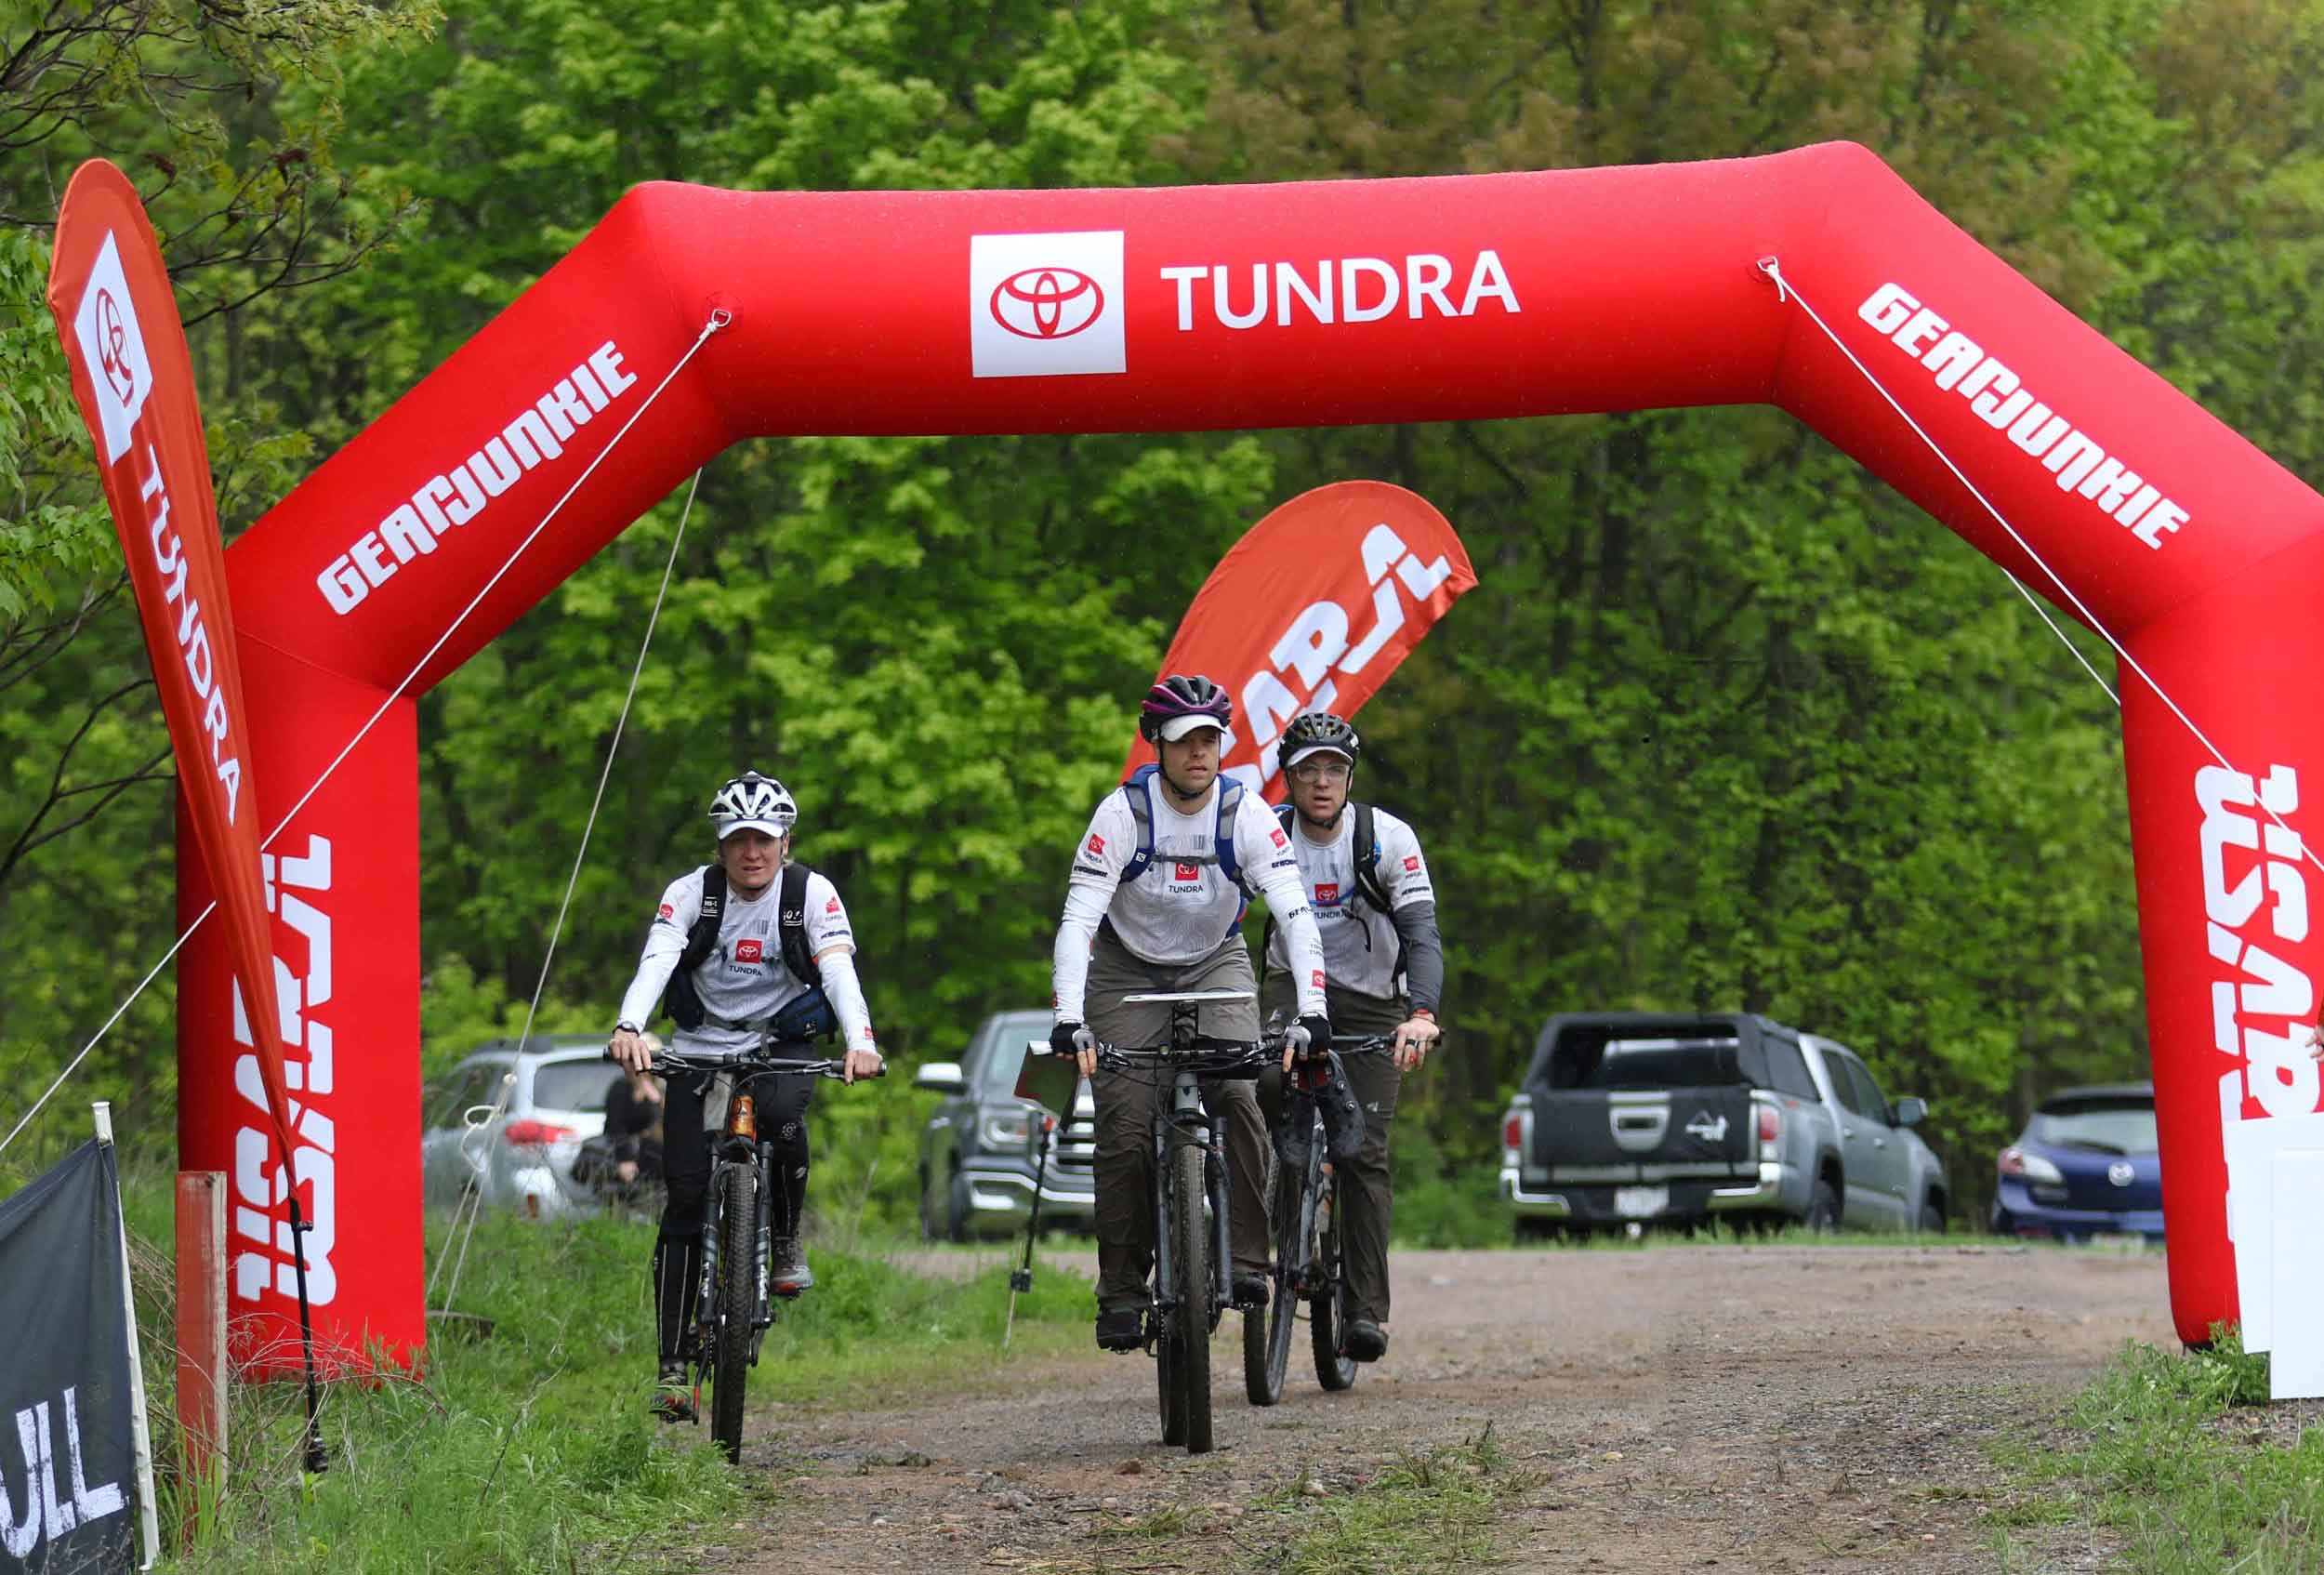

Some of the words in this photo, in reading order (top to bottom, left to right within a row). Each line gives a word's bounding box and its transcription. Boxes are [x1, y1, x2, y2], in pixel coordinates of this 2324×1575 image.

[1159, 249, 1521, 332] TUNDRA
[1857, 281, 2191, 550] GEARJUNKIE
[316, 339, 638, 616] GEARJUNKIE
[141, 443, 241, 827] TUNDRA
[729, 964, 762, 977] TUNDRA
[1169, 884, 1204, 893] TUNDRA
[2194, 762, 2321, 1242] USAR
